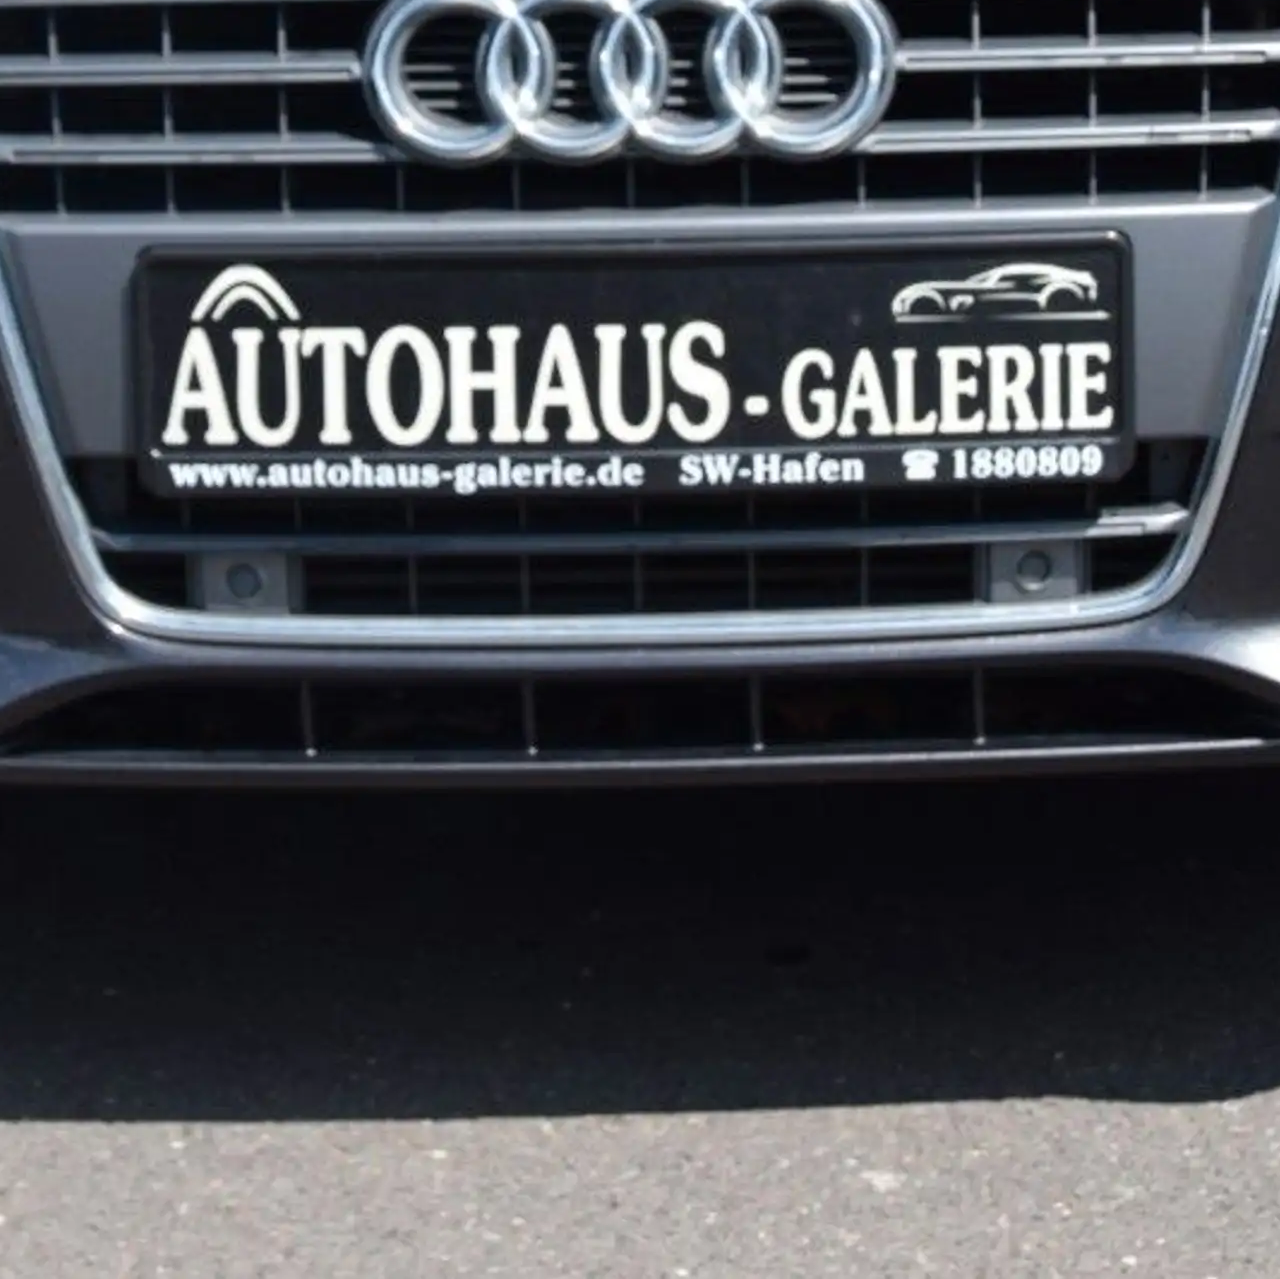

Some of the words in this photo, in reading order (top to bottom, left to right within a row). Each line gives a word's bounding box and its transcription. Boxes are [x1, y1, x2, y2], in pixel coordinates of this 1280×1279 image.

[161, 320, 731, 447] AUTOHAUS
[781, 341, 1115, 441] GALERIE
[168, 455, 645, 495] www.autohaus-galerie.de
[678, 451, 866, 486] SW-Hafen
[951, 444, 1105, 480] 1880809
